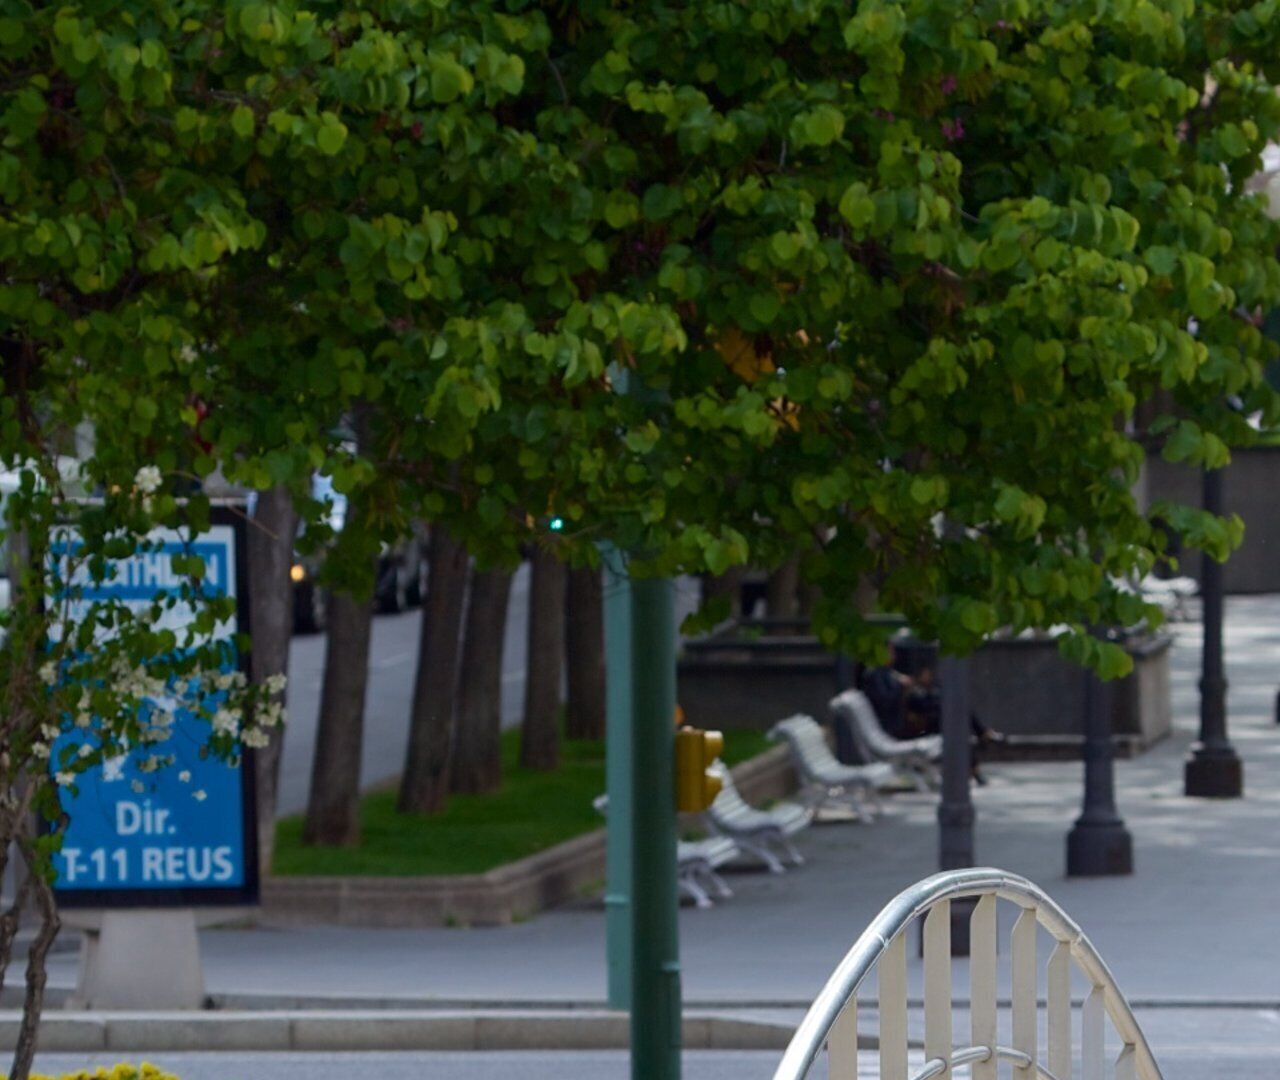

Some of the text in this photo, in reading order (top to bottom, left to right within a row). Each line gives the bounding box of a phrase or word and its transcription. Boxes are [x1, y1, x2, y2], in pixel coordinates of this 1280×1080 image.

[116, 798, 176, 836] Dir.
[61, 846, 233, 882] T-11 REUS
